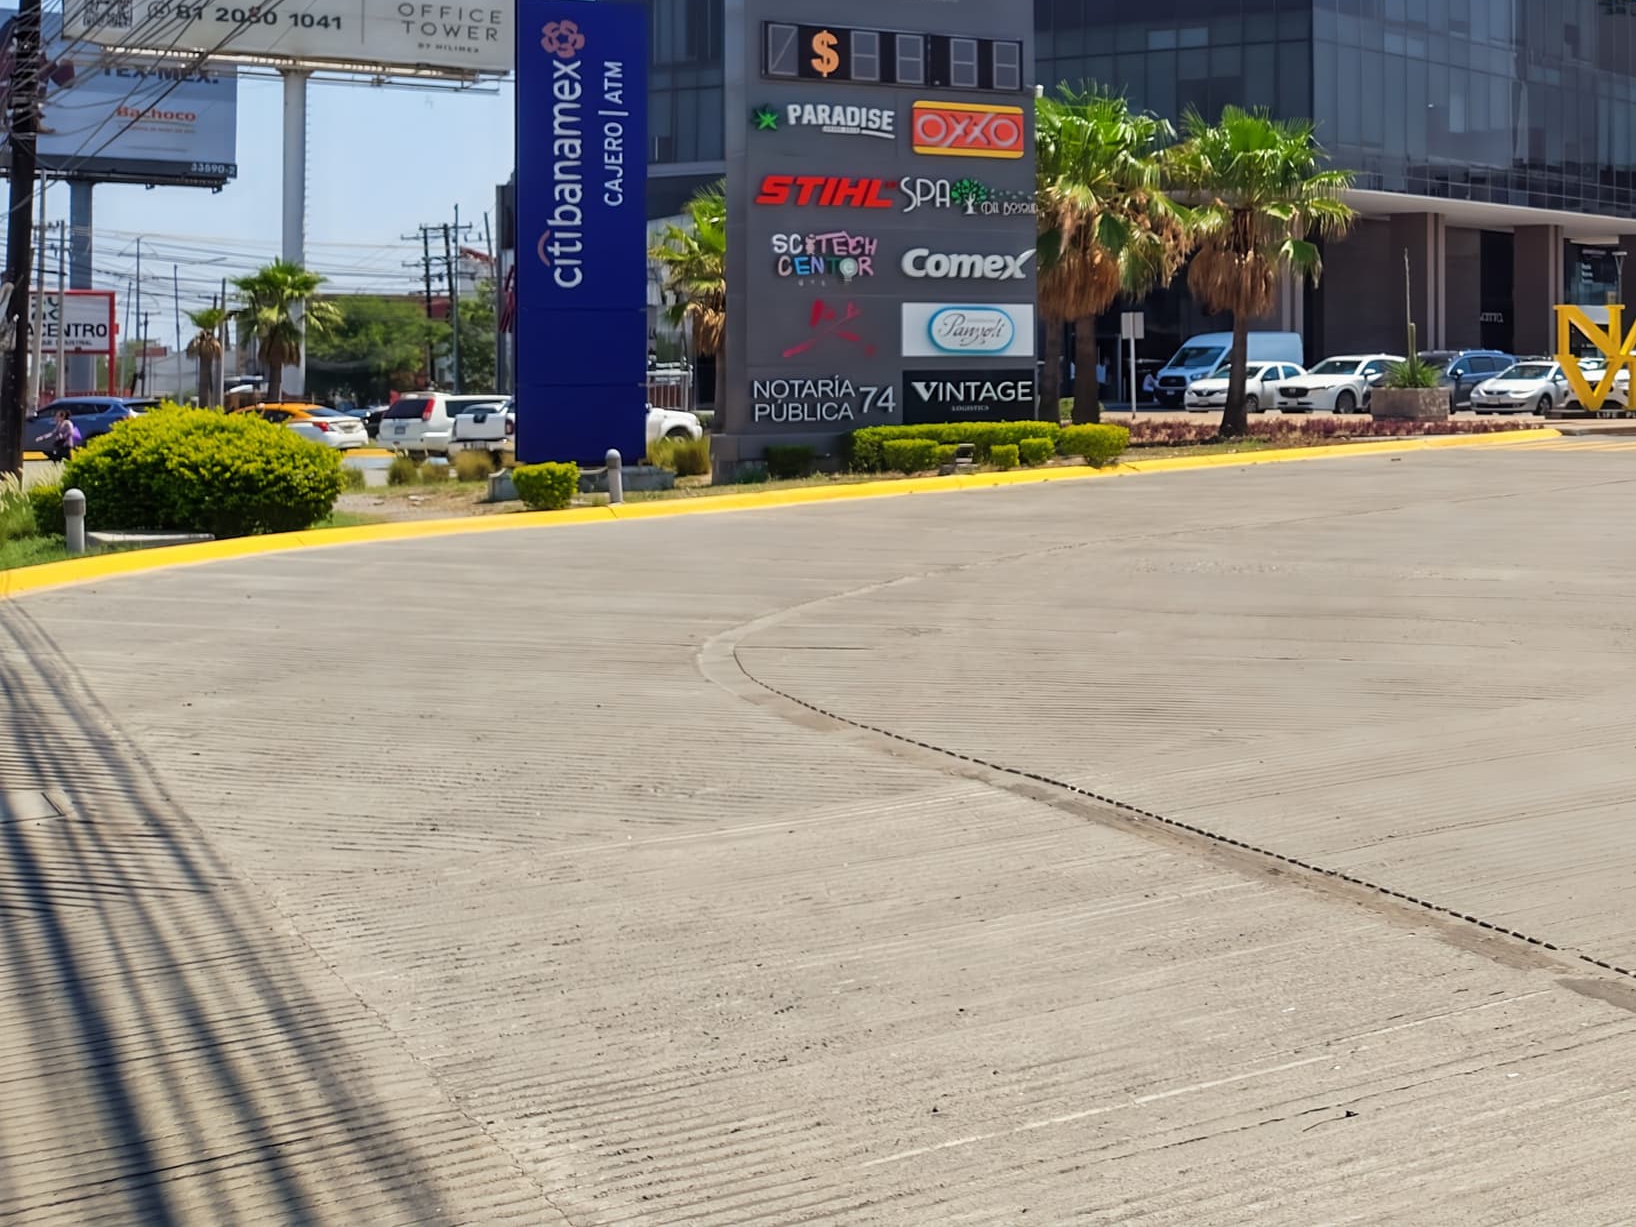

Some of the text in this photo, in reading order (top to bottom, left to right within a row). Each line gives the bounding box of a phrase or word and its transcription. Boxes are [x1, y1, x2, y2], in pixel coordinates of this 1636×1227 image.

[176, 5, 203, 20] 81
[289, 13, 342, 29] 1041
[398, 2, 502, 24] OFFICE
[401, 19, 498, 42] TOWER
[116, 106, 196, 122] Bachoco
[787, 104, 895, 132] PARADISE
[604, 61, 624, 206] CAJERO ATM
[917, 112, 1019, 148] OXXO
[546, 59, 583, 288] citibanamex
[755, 175, 893, 208] STIHL
[900, 177, 950, 213] SPA
[902, 248, 1036, 280] Comex
[753, 375, 855, 399] NOTARÍA
[859, 385, 896, 413] 74
[911, 381, 1033, 402] VINTAGE
[755, 399, 854, 422] PÚBLICA
